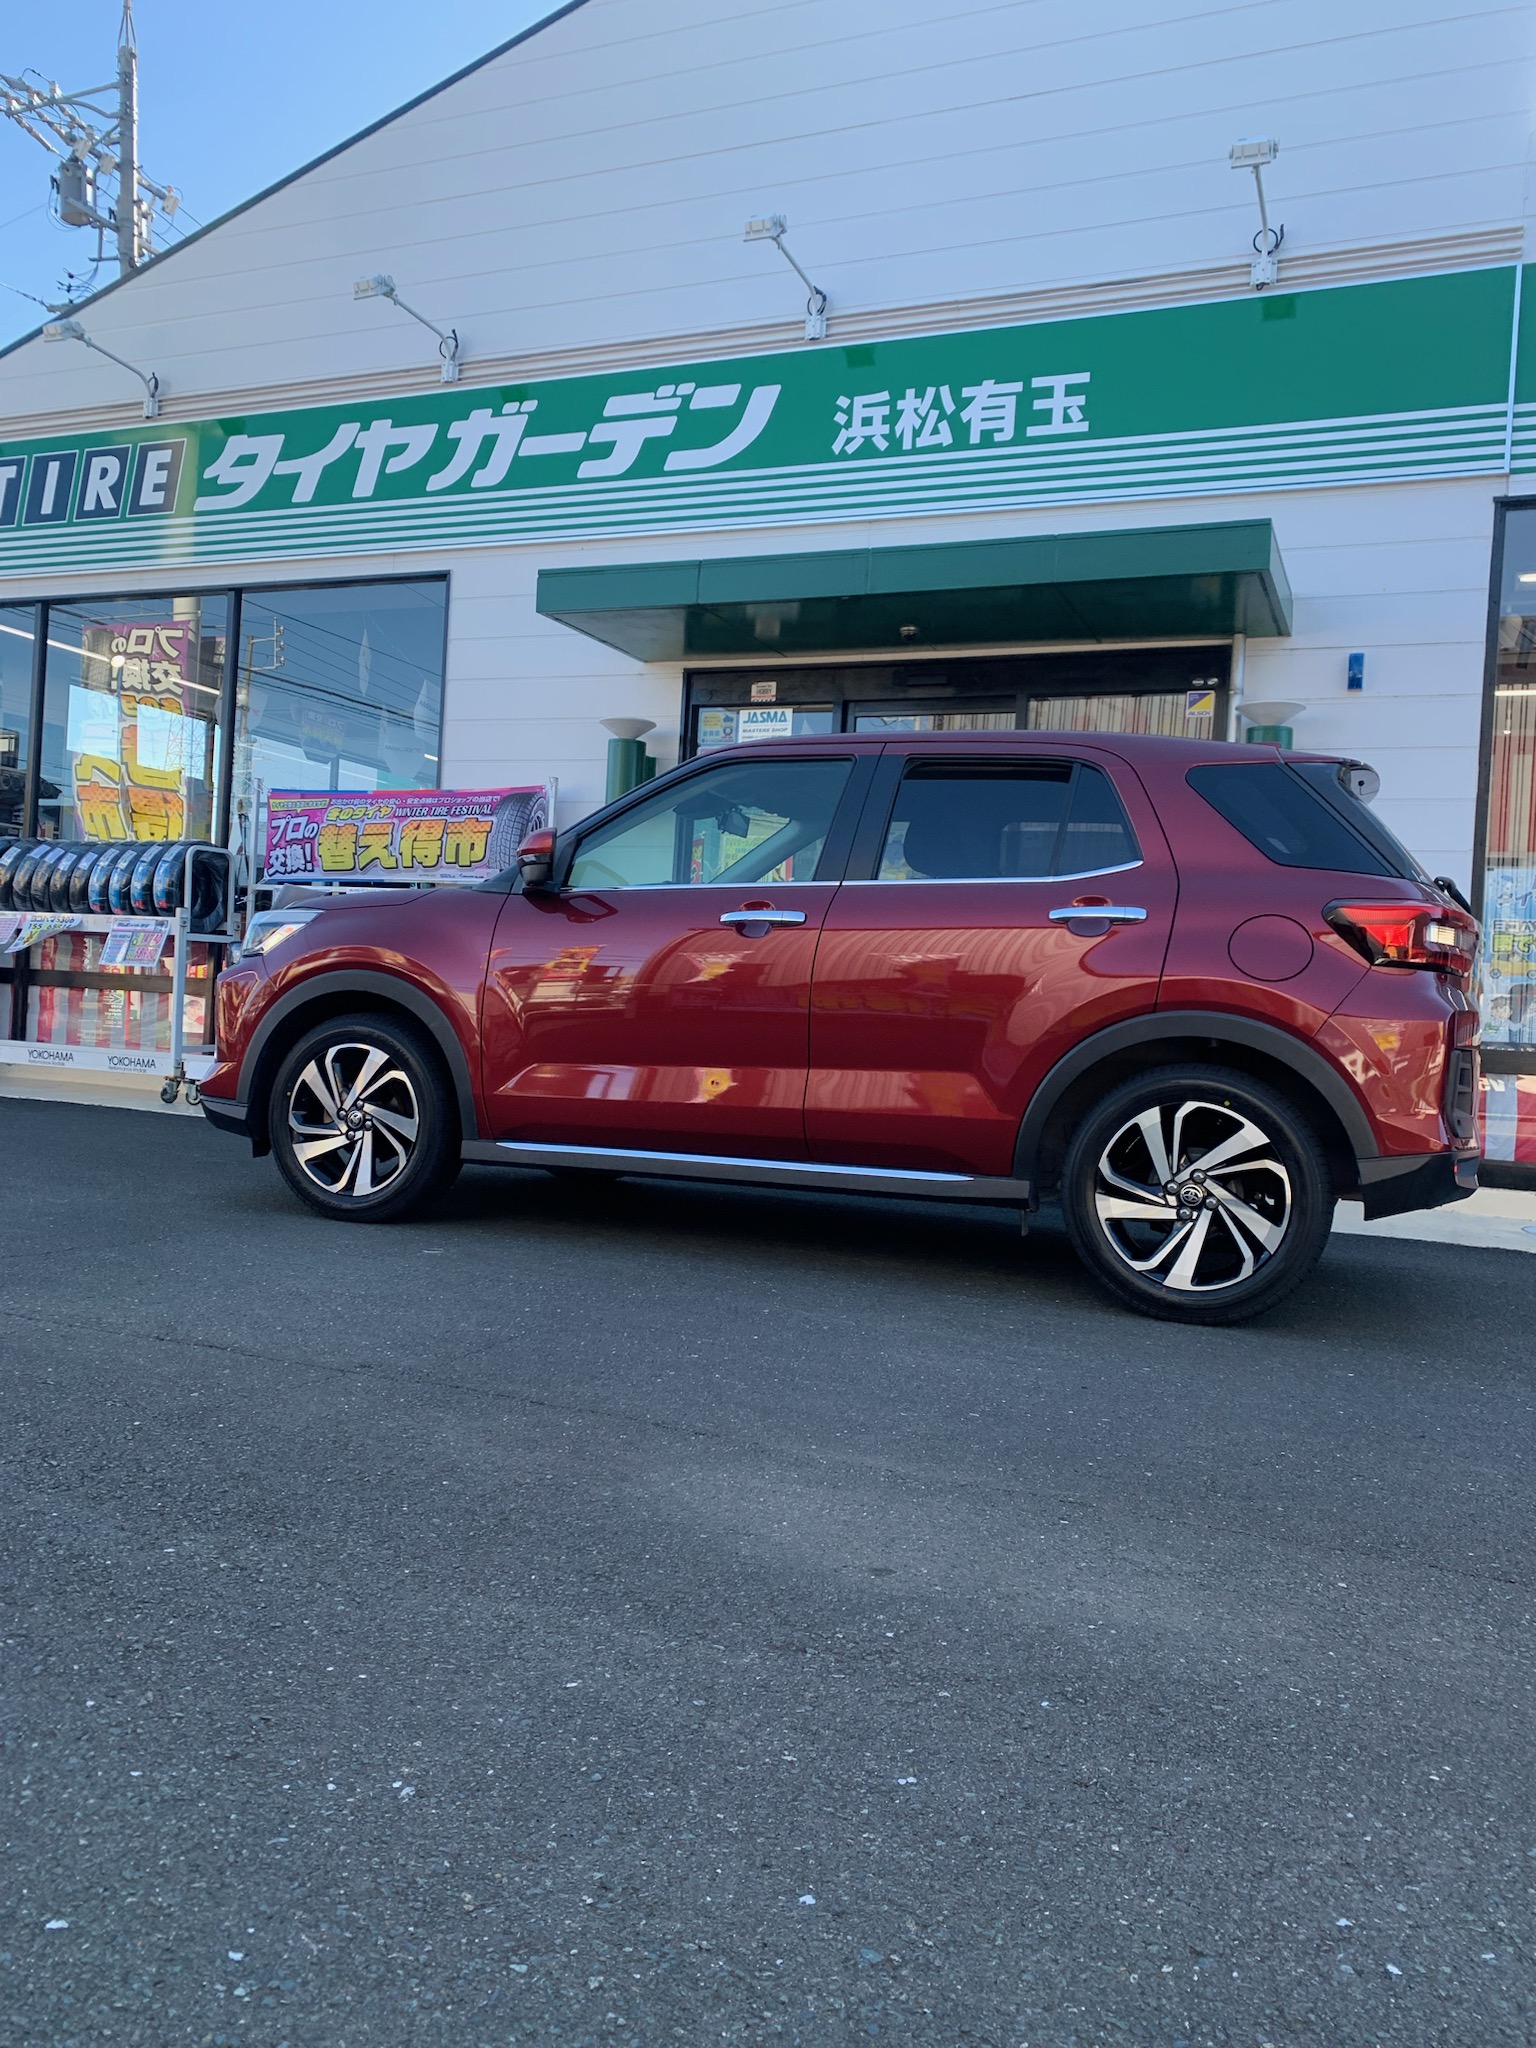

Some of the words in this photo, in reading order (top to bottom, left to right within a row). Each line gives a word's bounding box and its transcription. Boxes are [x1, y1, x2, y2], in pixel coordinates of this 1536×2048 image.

[194, 382, 781, 511] タイヤガーデン
[831, 372, 1091, 455] 浜松有玉
[0, 449, 172, 518] TIRE
[743, 710, 788, 724] JASMA
[326, 805, 394, 821] 冬のタイヤ
[395, 806, 428, 817] WINTER
[430, 806, 449, 816] TIRE
[450, 804, 493, 816] FESTIVAL
[270, 815, 319, 845] プロの
[318, 817, 493, 872] 替え得市
[267, 843, 314, 876] 交換!
[28, 1049, 74, 1062] YOKOHAMA
[107, 1055, 156, 1069] YOKOHAMA
